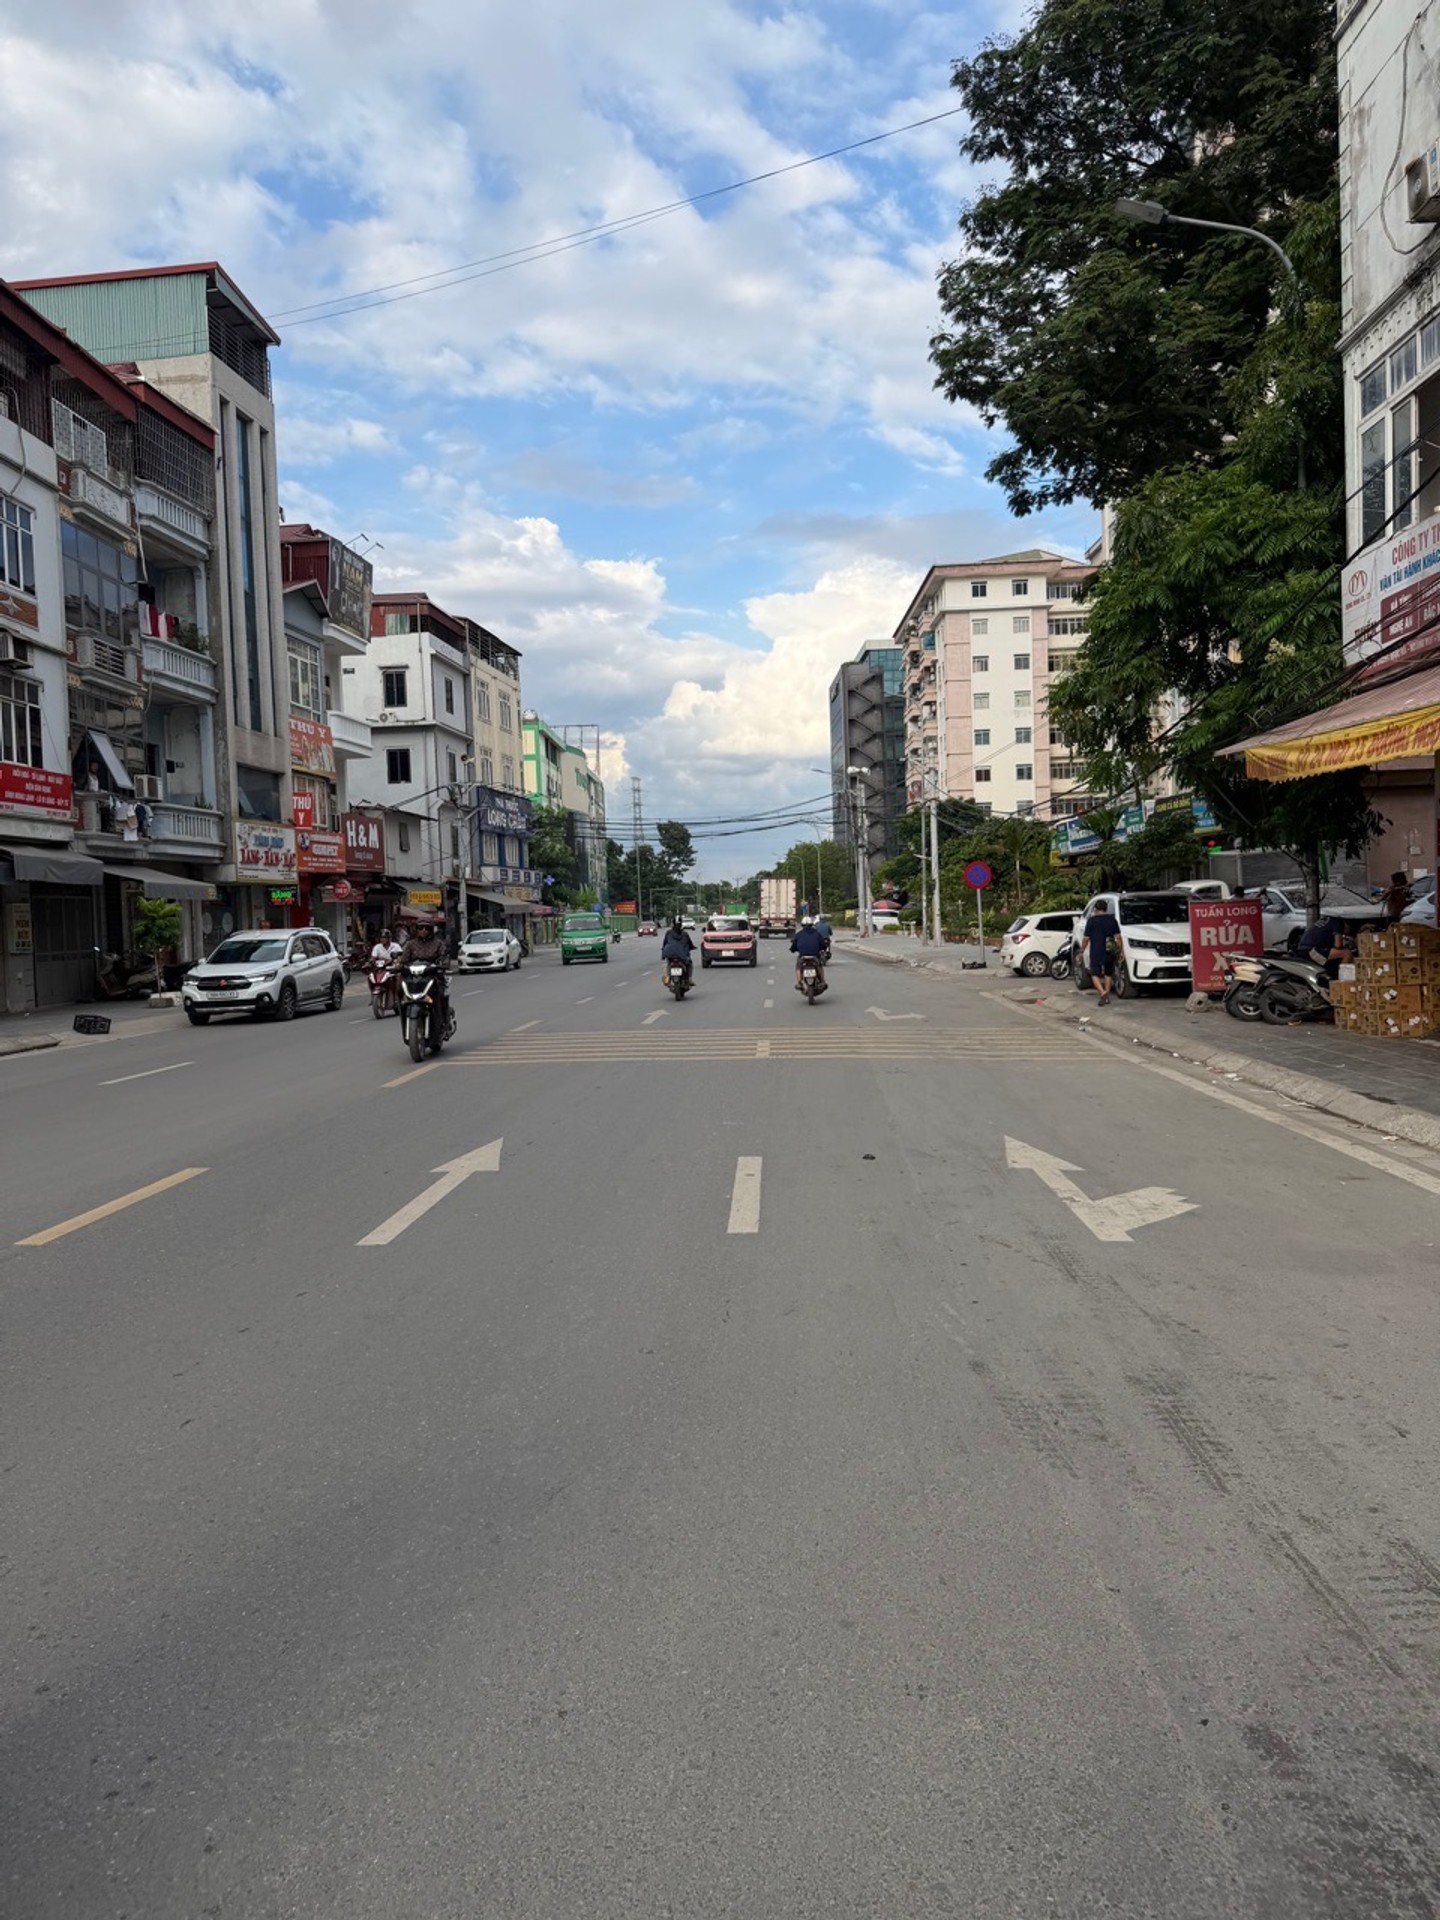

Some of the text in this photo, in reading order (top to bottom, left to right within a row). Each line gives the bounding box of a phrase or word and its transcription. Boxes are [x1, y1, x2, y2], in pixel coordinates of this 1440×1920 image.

[1392, 537, 1416, 565] CÔNG
[1418, 529, 1430, 551] TY
[298, 811, 305, 826] Y
[1195, 904, 1258, 918] TUẤN LONG
[1200, 919, 1255, 947] RỬA
